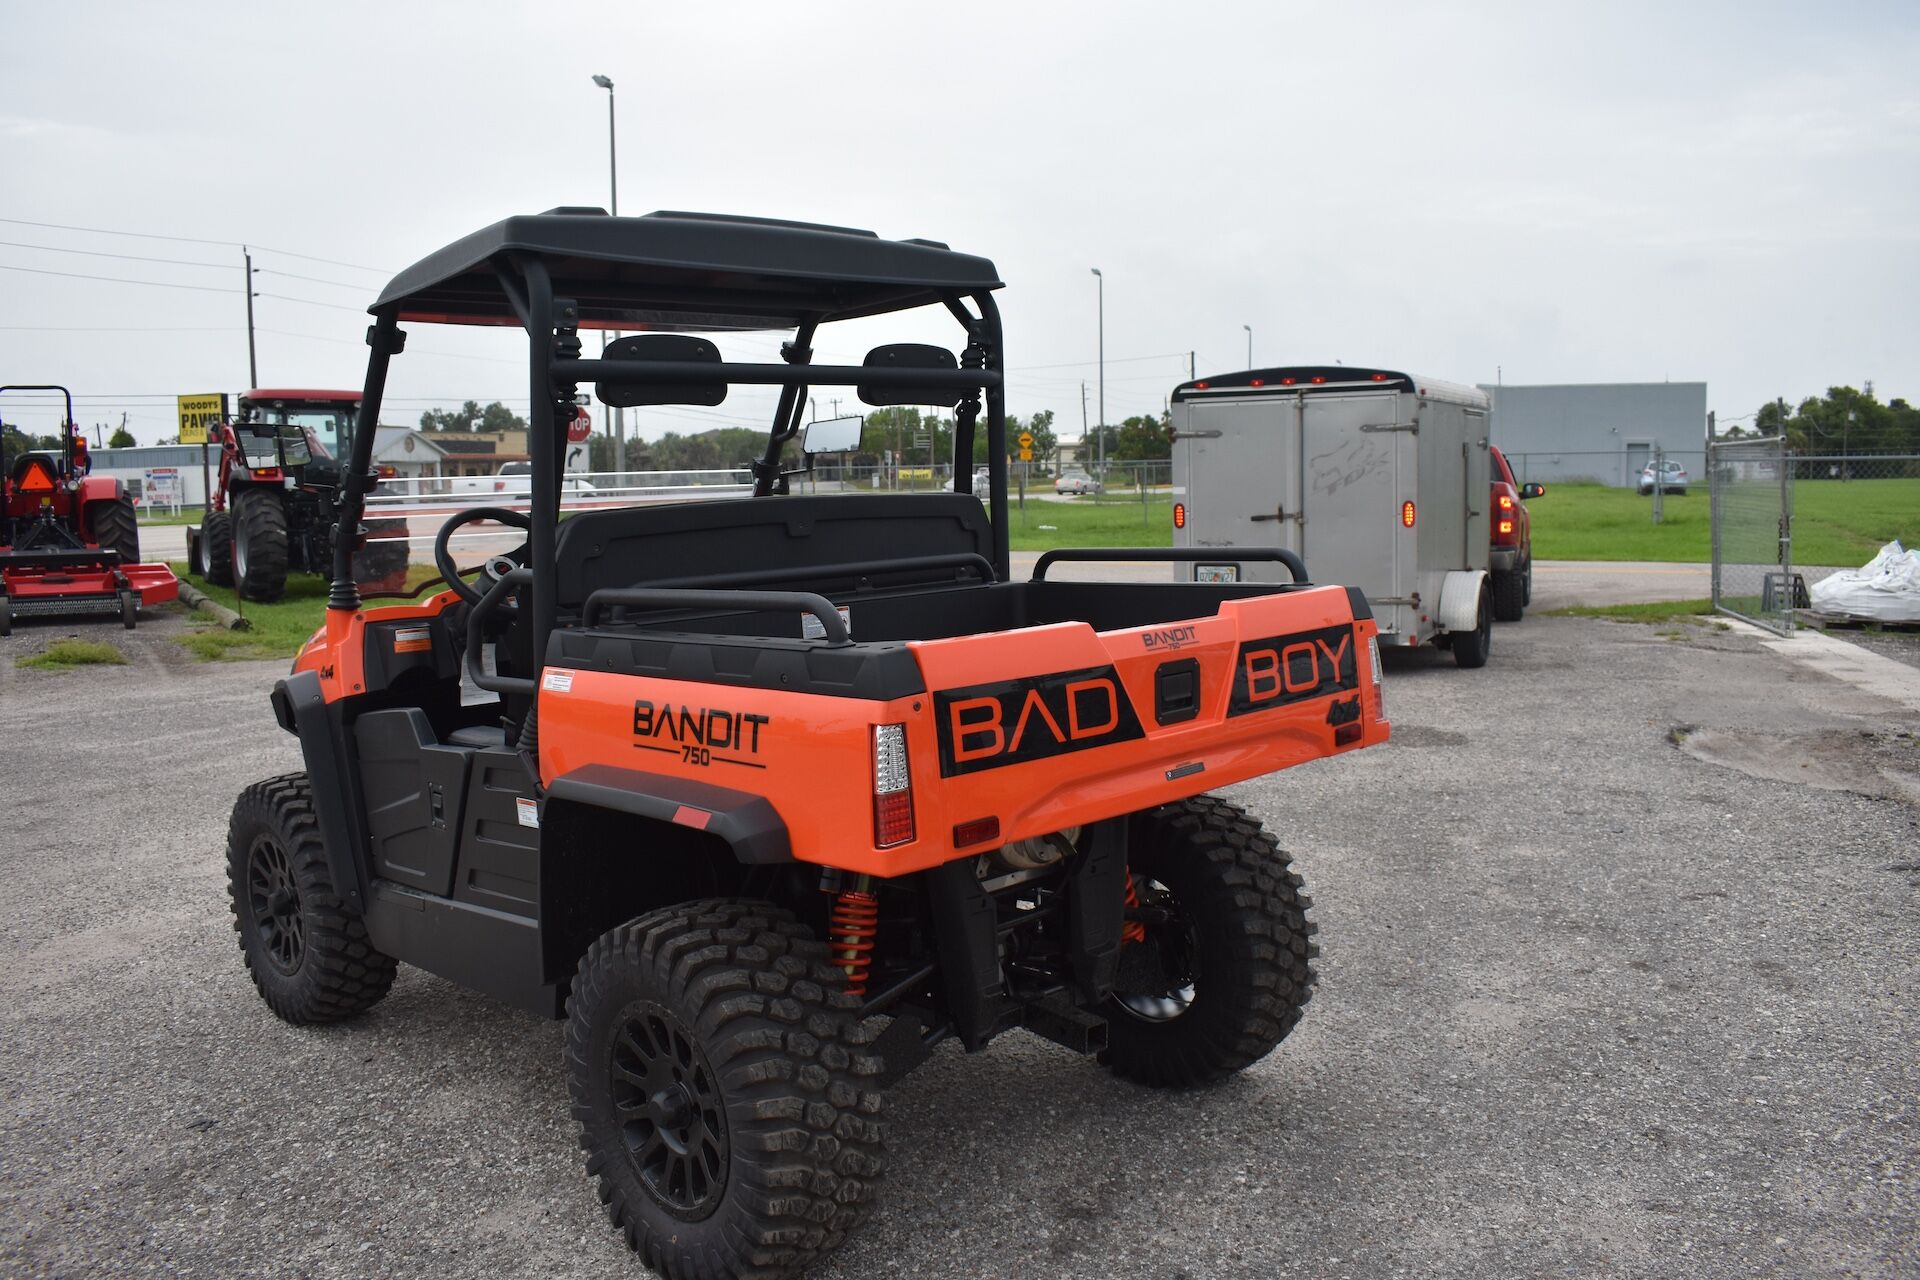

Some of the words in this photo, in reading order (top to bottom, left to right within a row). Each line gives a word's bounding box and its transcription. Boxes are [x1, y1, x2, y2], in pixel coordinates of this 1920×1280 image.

[182, 401, 218, 410] WOODY'S
[568, 417, 591, 432] TOP
[1142, 626, 1196, 647] BANDIT
[950, 677, 1119, 763] BAD
[1245, 633, 1350, 703] BOY
[633, 699, 769, 753] BANDIT
[682, 745, 710, 767] 750
